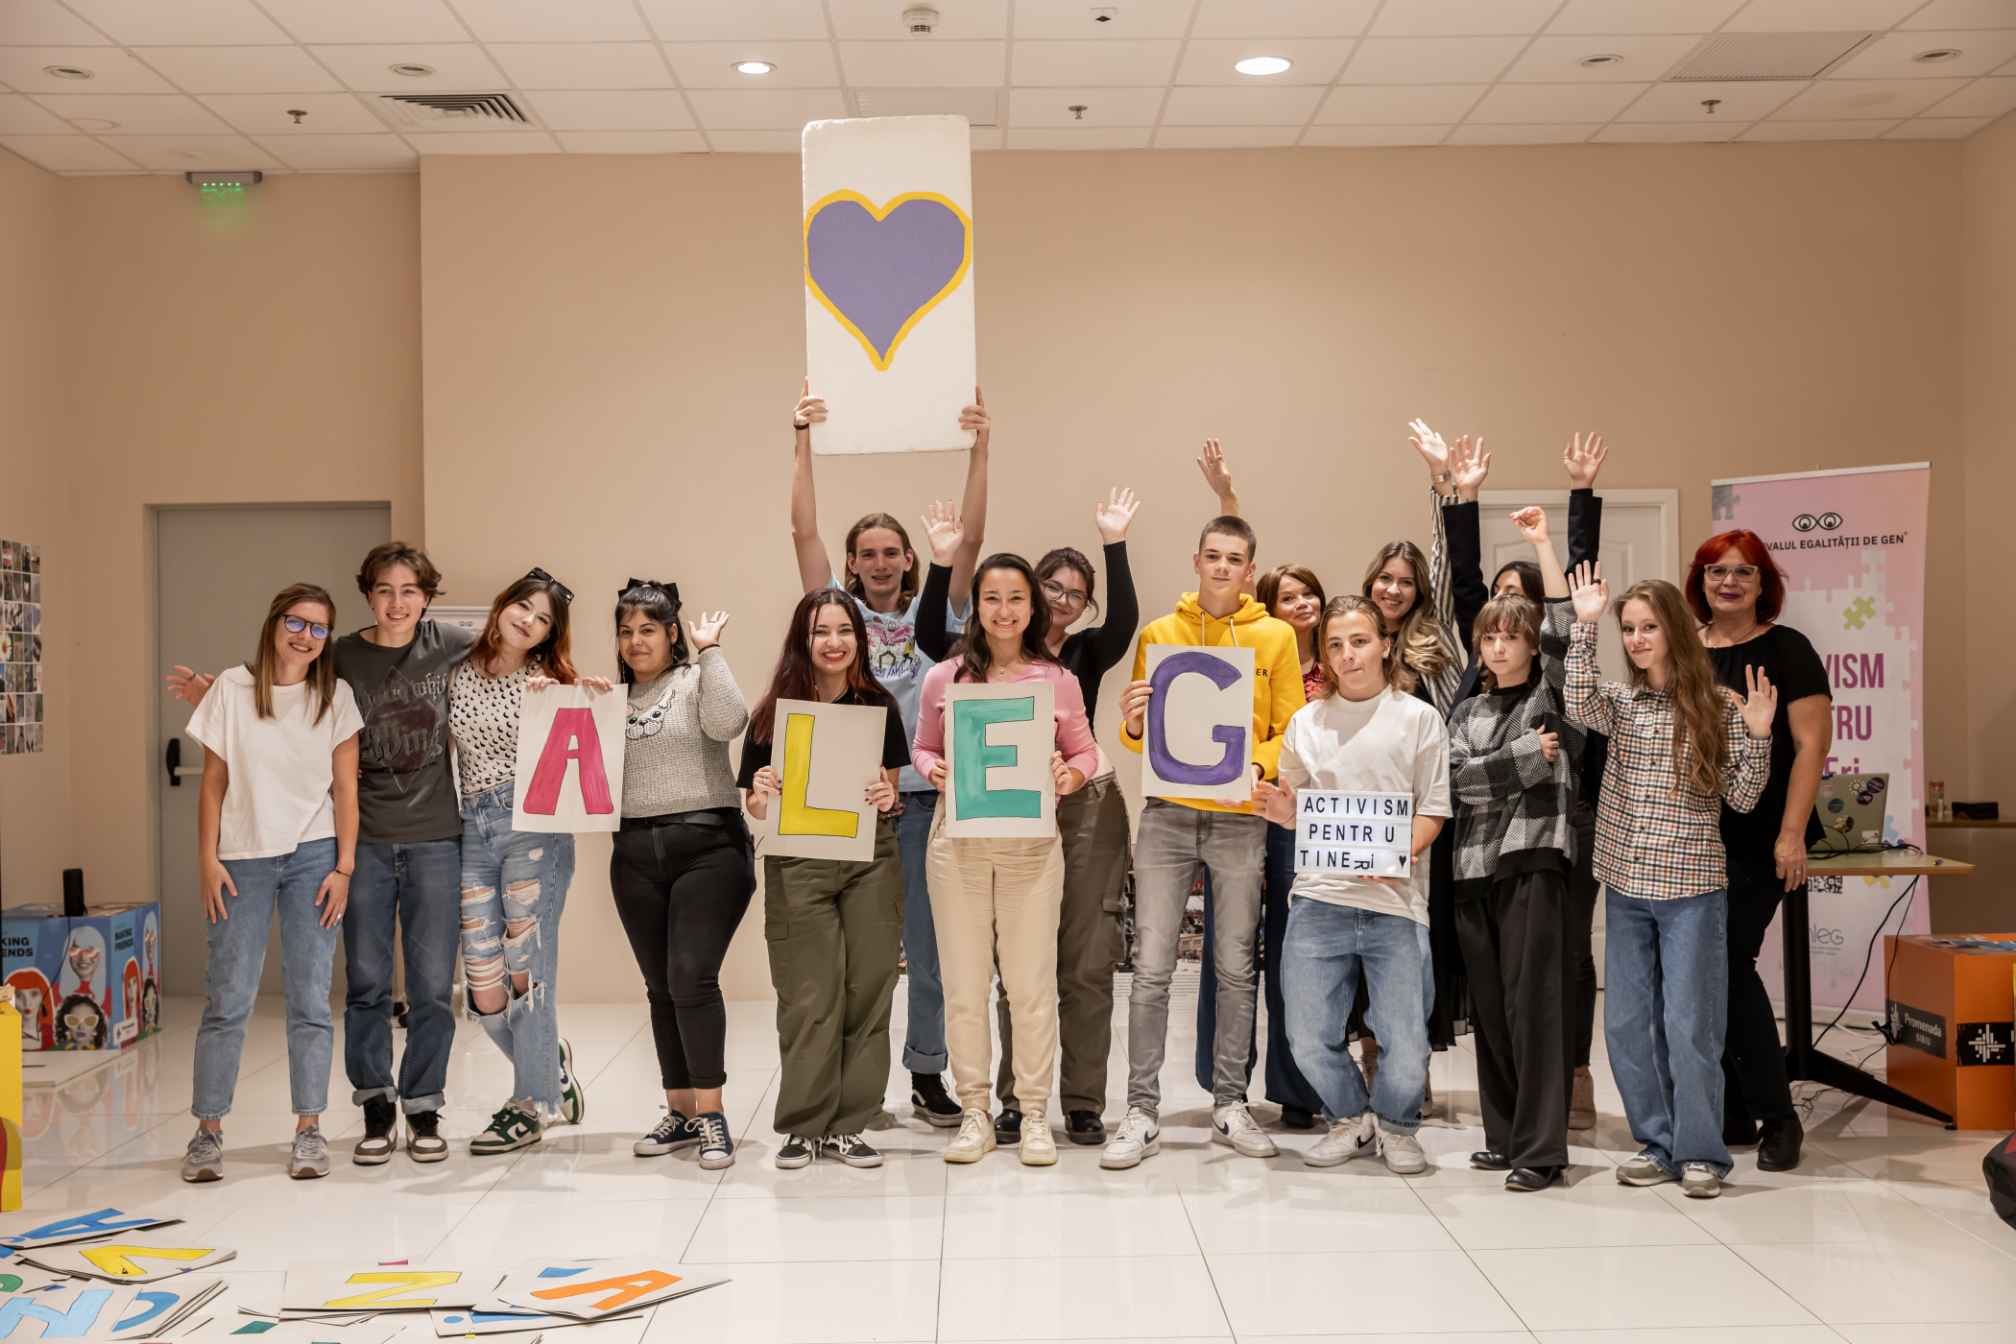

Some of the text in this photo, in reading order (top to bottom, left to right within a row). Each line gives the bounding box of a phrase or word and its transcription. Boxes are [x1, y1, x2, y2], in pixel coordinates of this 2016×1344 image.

[1863, 536, 1878, 545] DE
[1881, 534, 1905, 545] GEN
[1831, 704, 1872, 741] RU
[523, 651, 1247, 838] A L E G
[1303, 796, 1409, 817] ACTIVISM
